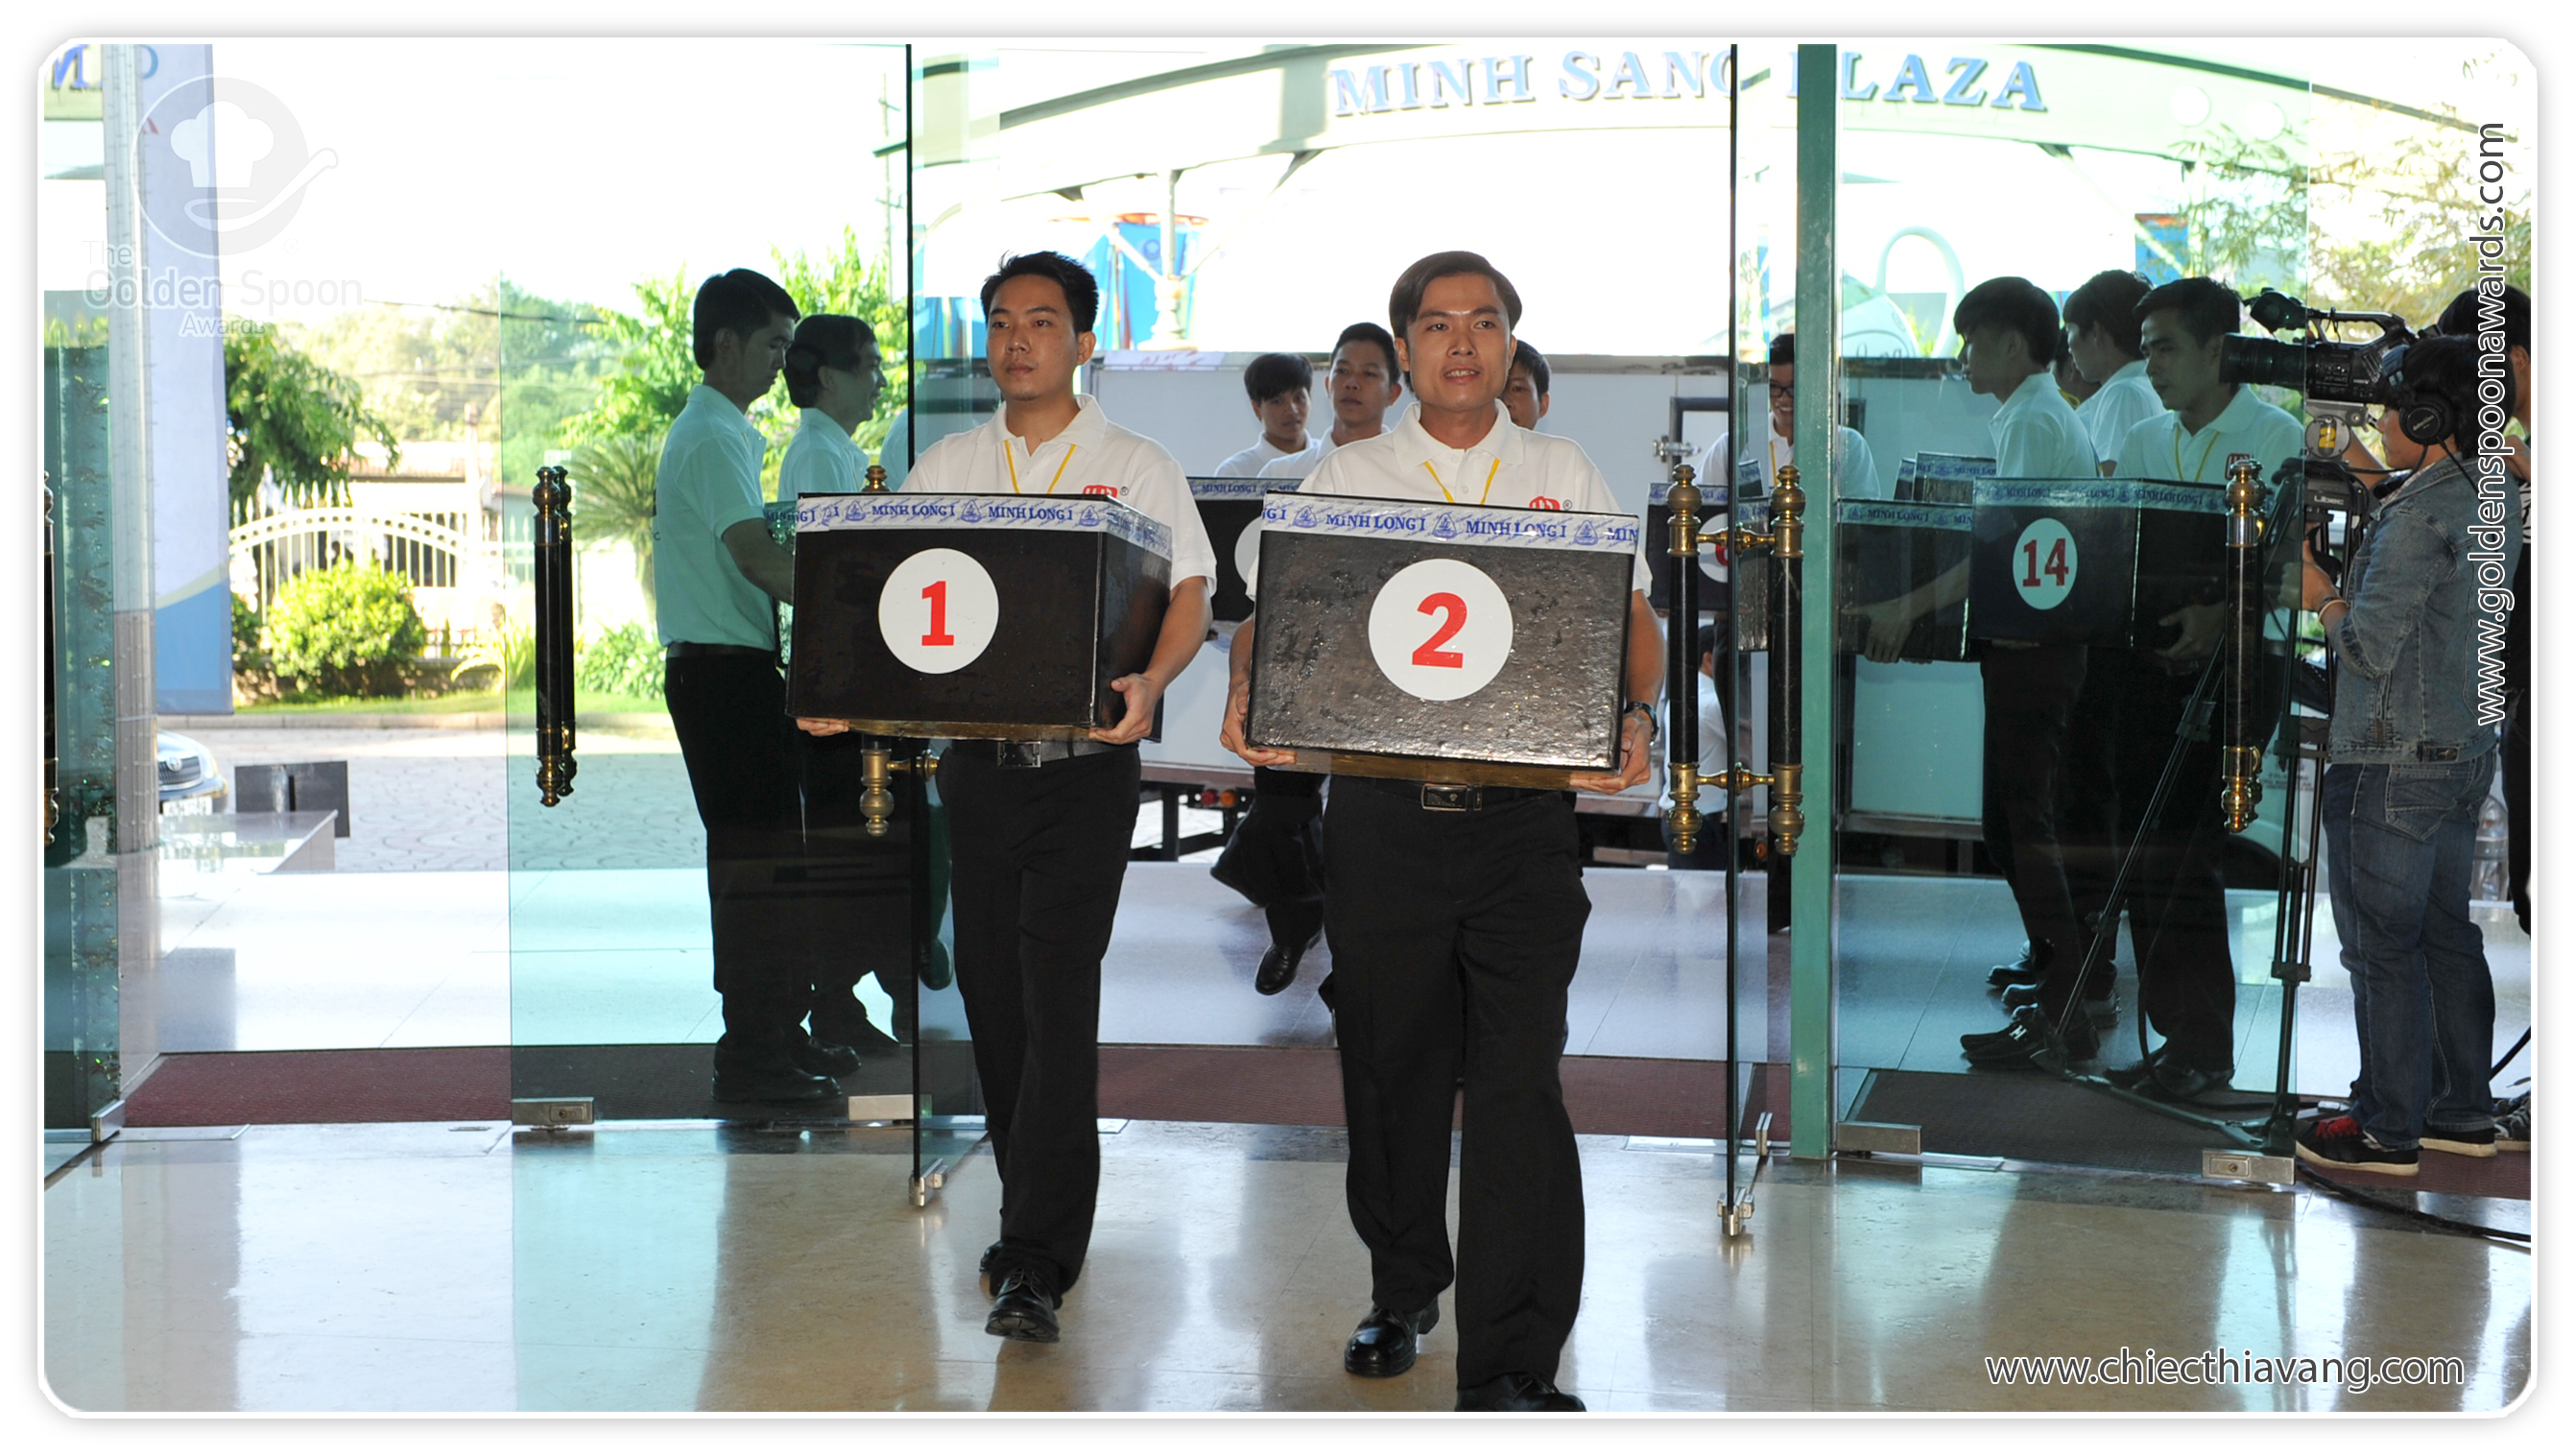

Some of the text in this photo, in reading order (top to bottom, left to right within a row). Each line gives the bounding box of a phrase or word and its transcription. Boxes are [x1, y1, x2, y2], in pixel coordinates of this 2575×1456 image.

[1329, 55, 1536, 117] MINH
[1787, 51, 2047, 113] LAZA
[2318, 426, 2337, 448] 2
[1202, 484, 1227, 493] MINH
[871, 505, 909, 516] MINH
[912, 505, 947, 516] LONG
[988, 506, 1026, 519] MINH
[1029, 508, 1065, 520] LONG
[1868, 509, 1895, 520] MINH
[1897, 511, 1923, 522] LONG
[1326, 513, 1371, 529] MINH
[1373, 515, 1417, 531] LONG
[1466, 520, 1512, 537] MINH
[1514, 522, 1557, 538] LONG
[2022, 537, 2070, 587] 14
[921, 581, 955, 646] 1
[1411, 591, 1468, 669] 2
